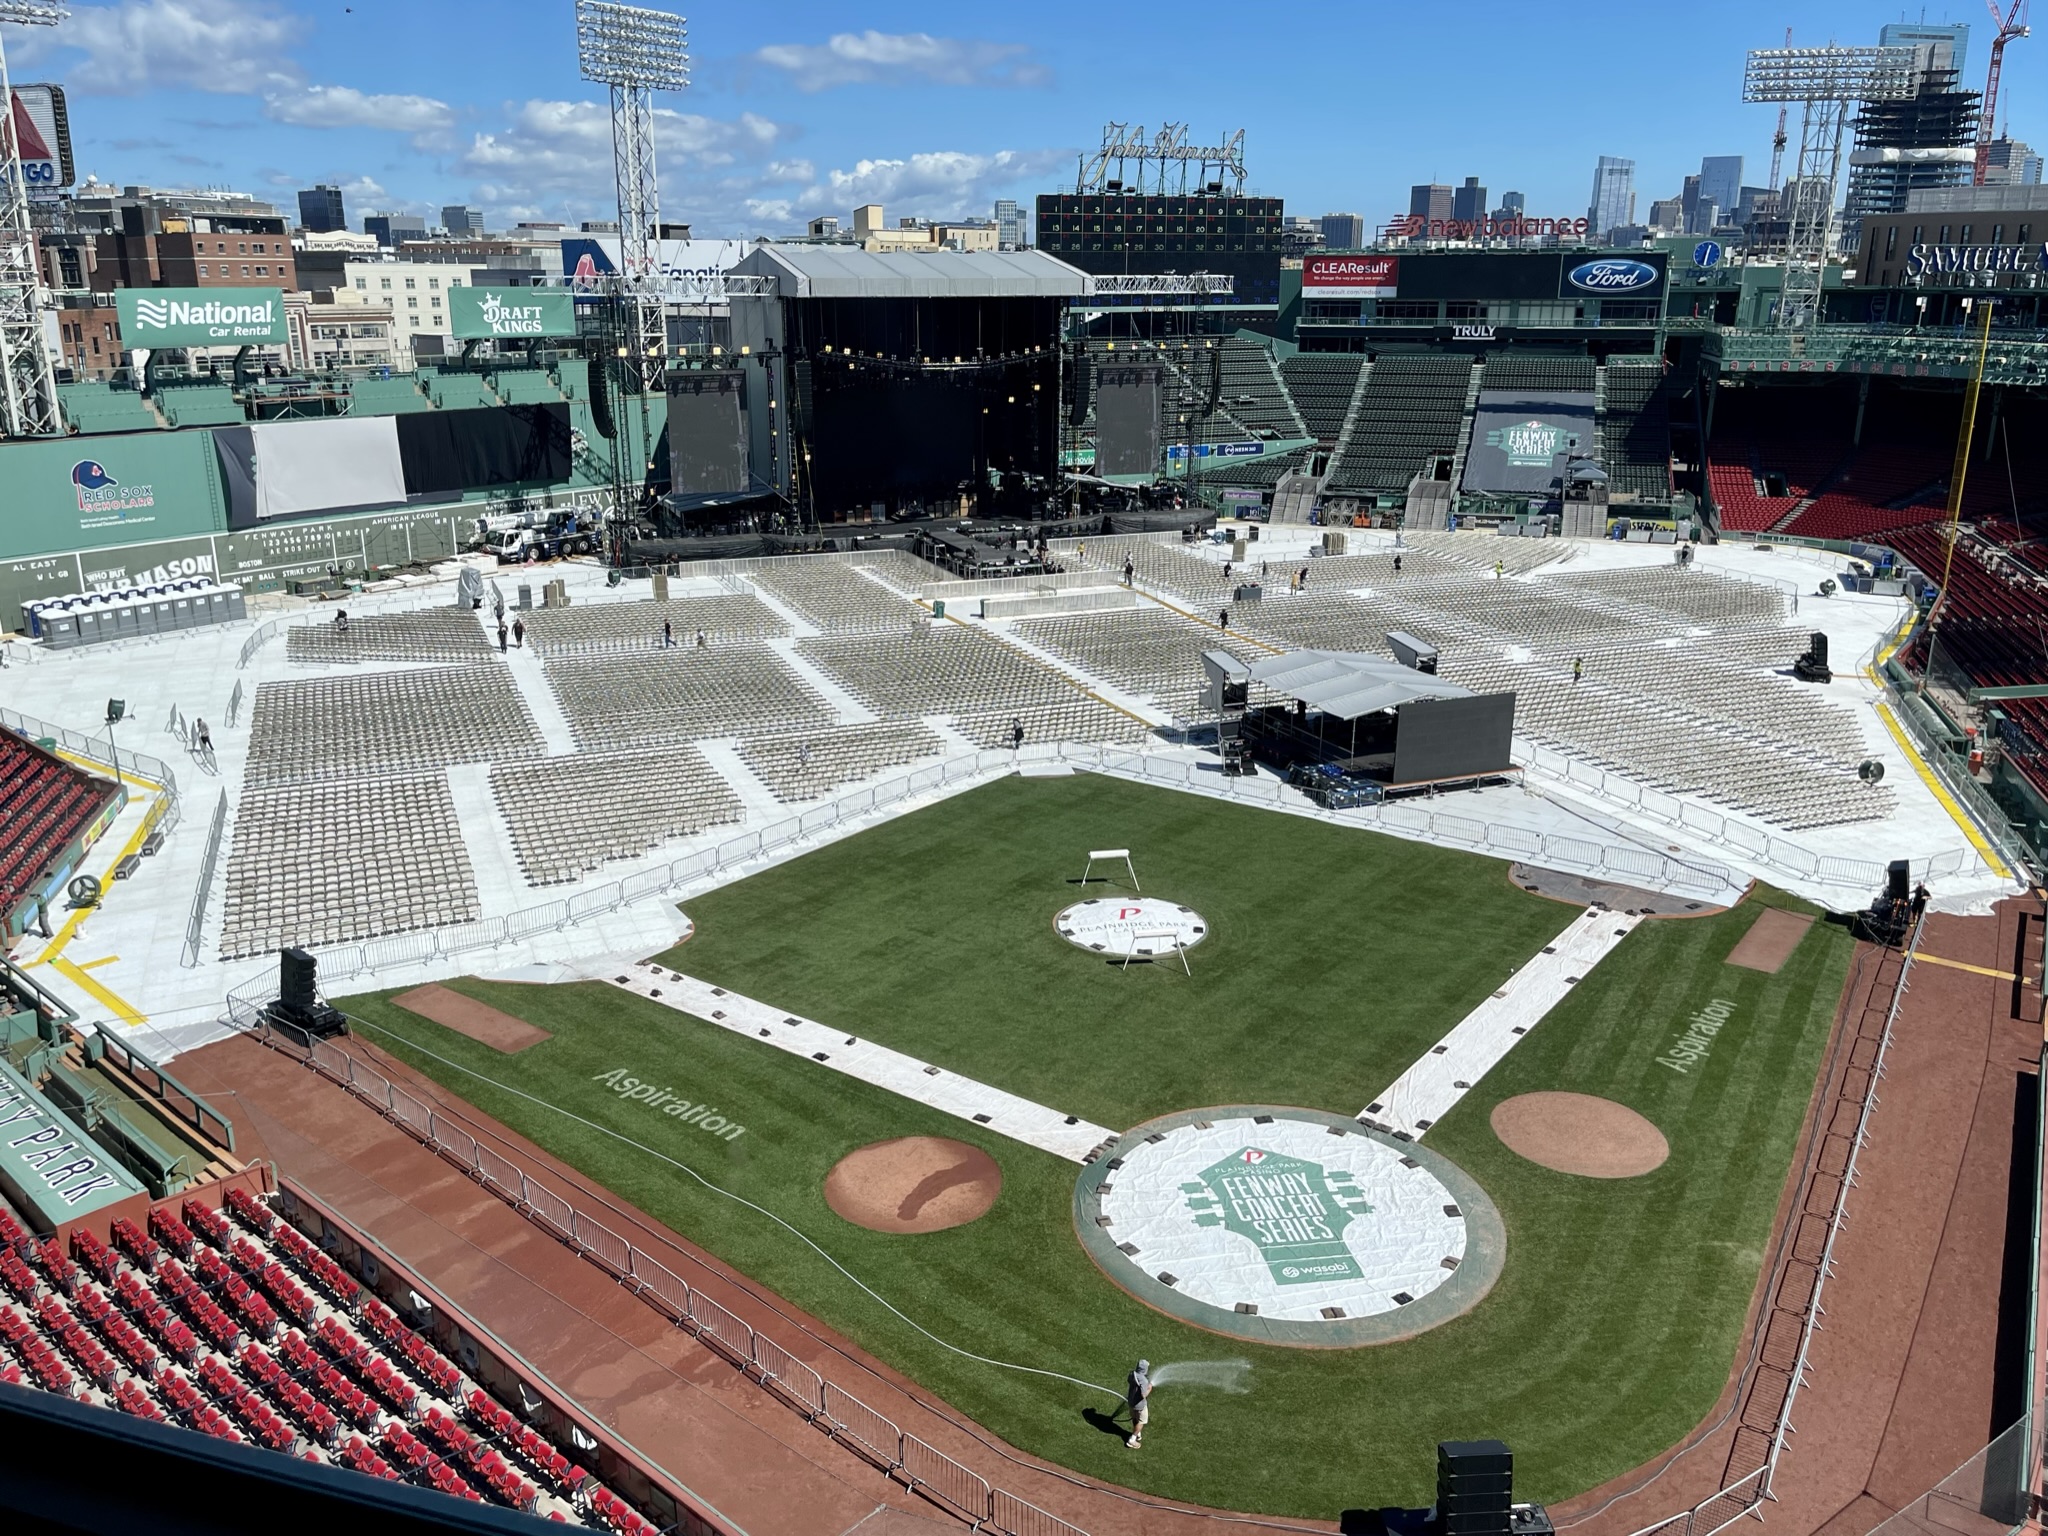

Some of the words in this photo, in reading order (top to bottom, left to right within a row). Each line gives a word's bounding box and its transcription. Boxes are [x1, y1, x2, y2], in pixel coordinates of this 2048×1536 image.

[1080, 120, 1148, 188] John
[1150, 121, 1248, 179] Hancock
[1429, 218, 1479, 237] new
[1482, 213, 1589, 237] balance
[1312, 262, 1389, 274] CLEAResult
[1907, 244, 2027, 276] SAMUEL
[1586, 264, 1640, 286] Ford
[483, 306, 542, 323] DRAFT
[209, 327, 230, 337] Car
[234, 325, 271, 336] Rental
[492, 320, 542, 334] KINGS
[1453, 325, 1498, 338] TRULY
[1510, 430, 1556, 440] FENWAY
[1509, 440, 1556, 448] CONCERT
[1513, 446, 1550, 456] SERIES
[84, 488, 116, 503] RED
[121, 485, 154, 498] SOX
[84, 496, 154, 512] SCHOLARS
[372, 515, 410, 525] AMERICAN
[412, 512, 440, 520] LEAGUE
[245, 529, 294, 541] FENWAY
[303, 525, 332, 534] PARK
[31, 560, 57, 570] EAST
[134, 555, 214, 586] MASON
[239, 559, 262, 568] BOSTON
[86, 572, 107, 582] WHO
[109, 569, 126, 578] BUT
[282, 568, 304, 578] STRIKE
[1655, 999, 1738, 1074] Aspiration
[592, 1068, 746, 1141] Aspiration
[8, 1124, 120, 1206] PARK
[1215, 1164, 1276, 1174] PLAINRIDGE
[1222, 1172, 1311, 1199] FENWAY
[1232, 1193, 1329, 1222] CONCERT
[1252, 1216, 1334, 1244] SERIES
[1300, 1262, 1348, 1274] wasabi
